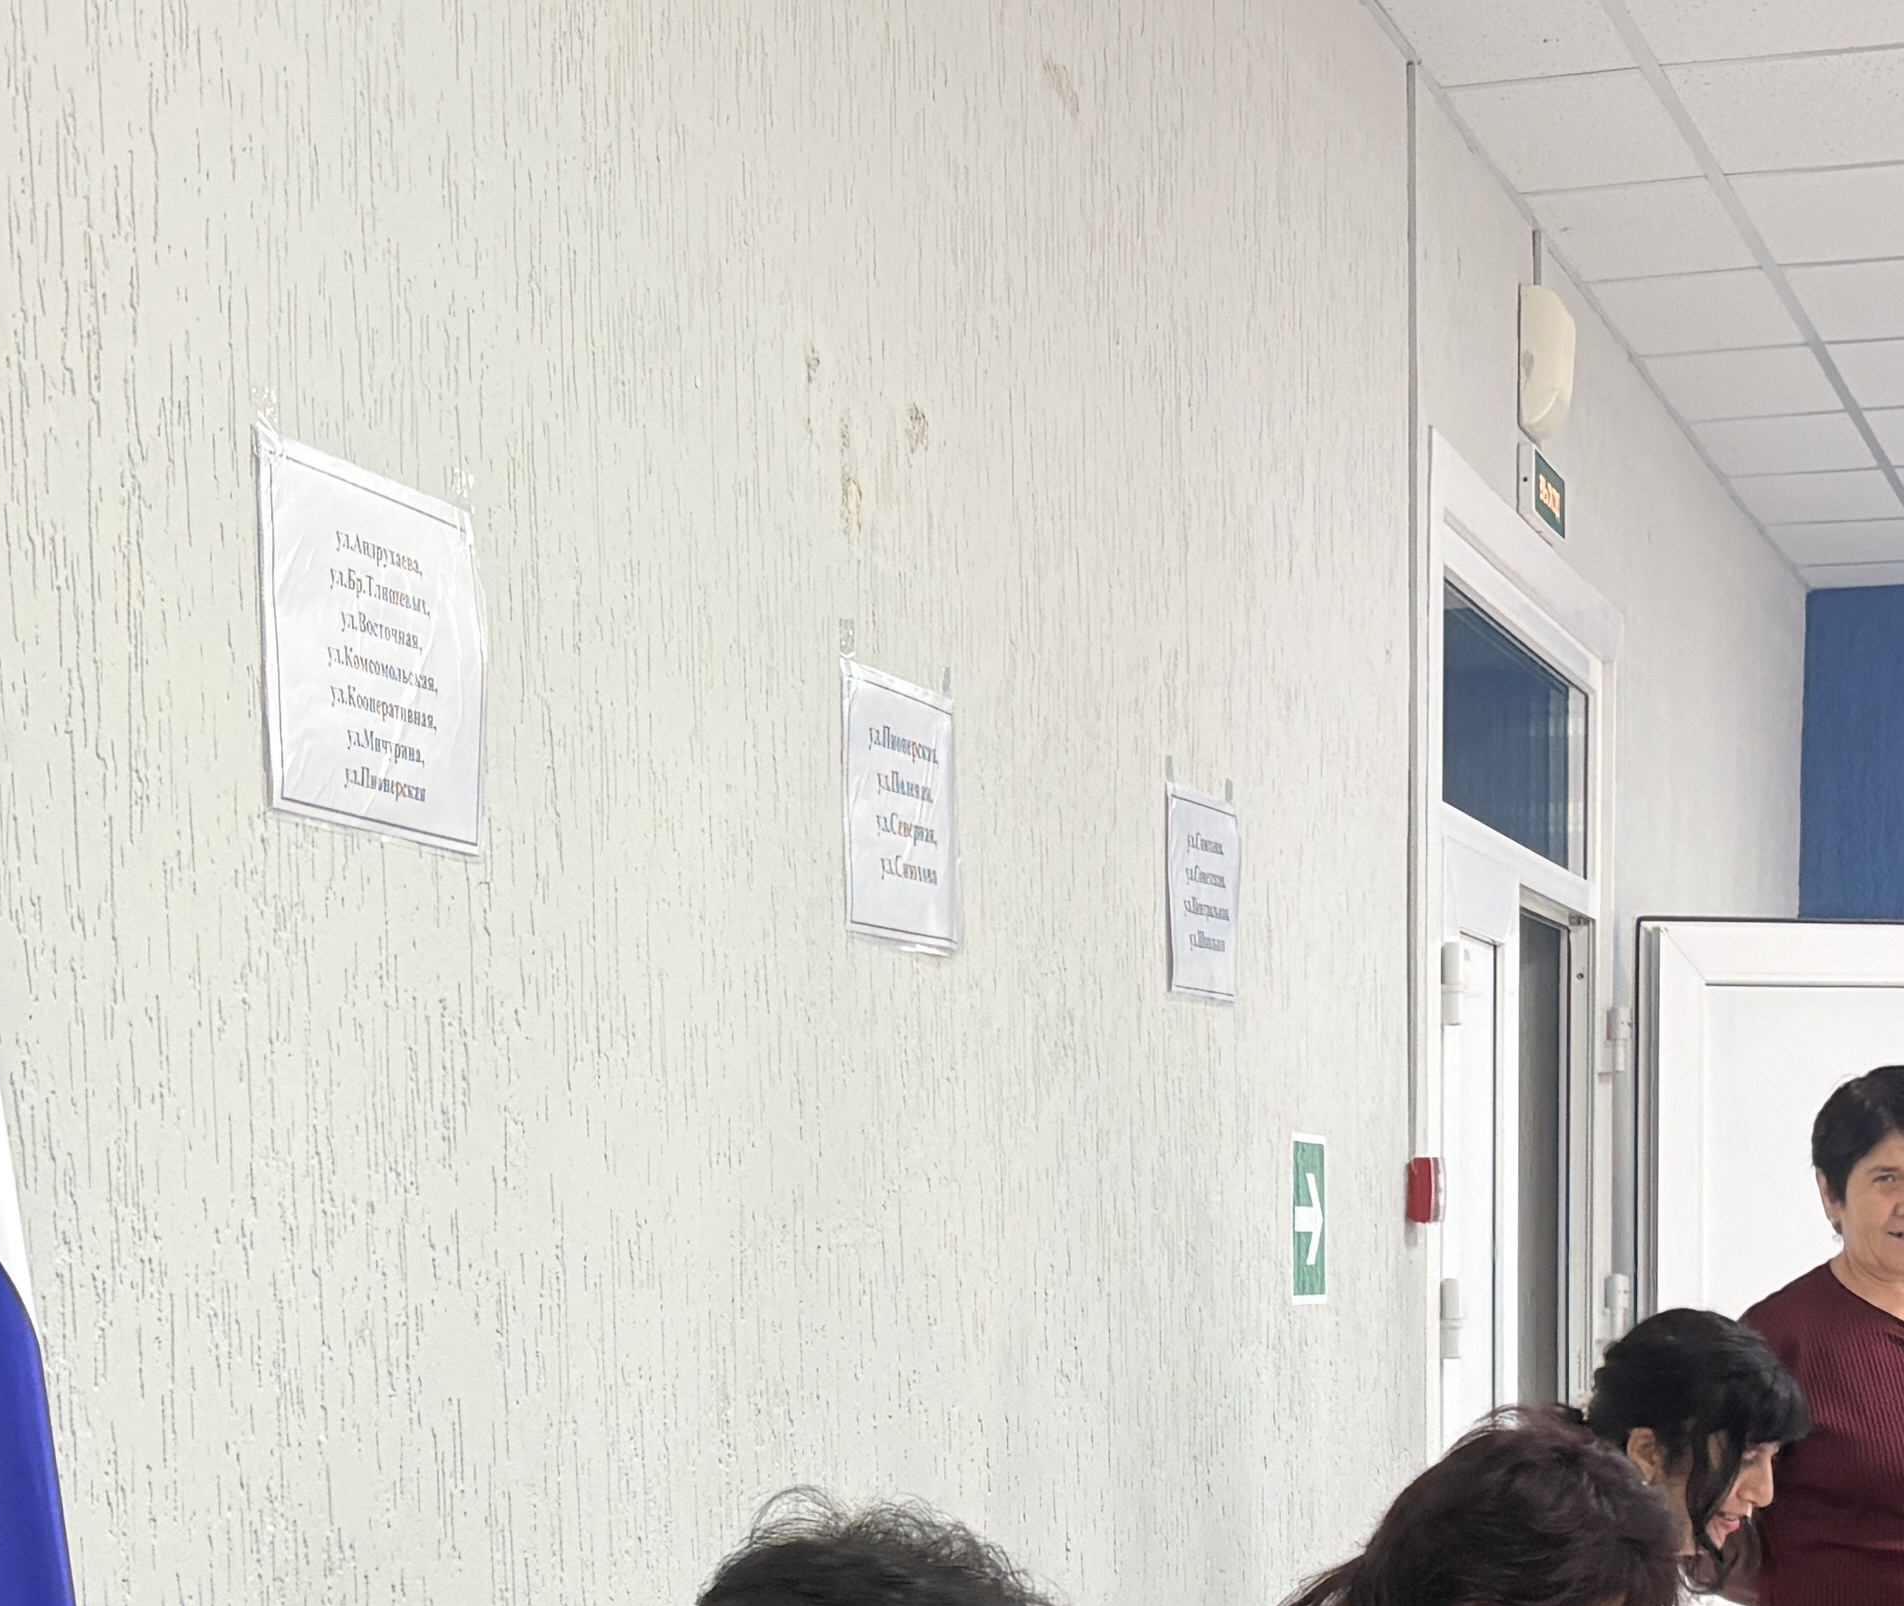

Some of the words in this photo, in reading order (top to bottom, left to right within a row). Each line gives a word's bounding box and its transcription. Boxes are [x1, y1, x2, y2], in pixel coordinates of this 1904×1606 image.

[341, 612, 422, 651] ул.Восточная,
[327, 645, 438, 694] ул.Комсомольская,
[330, 685, 437, 731] ул.Кооперативная,
